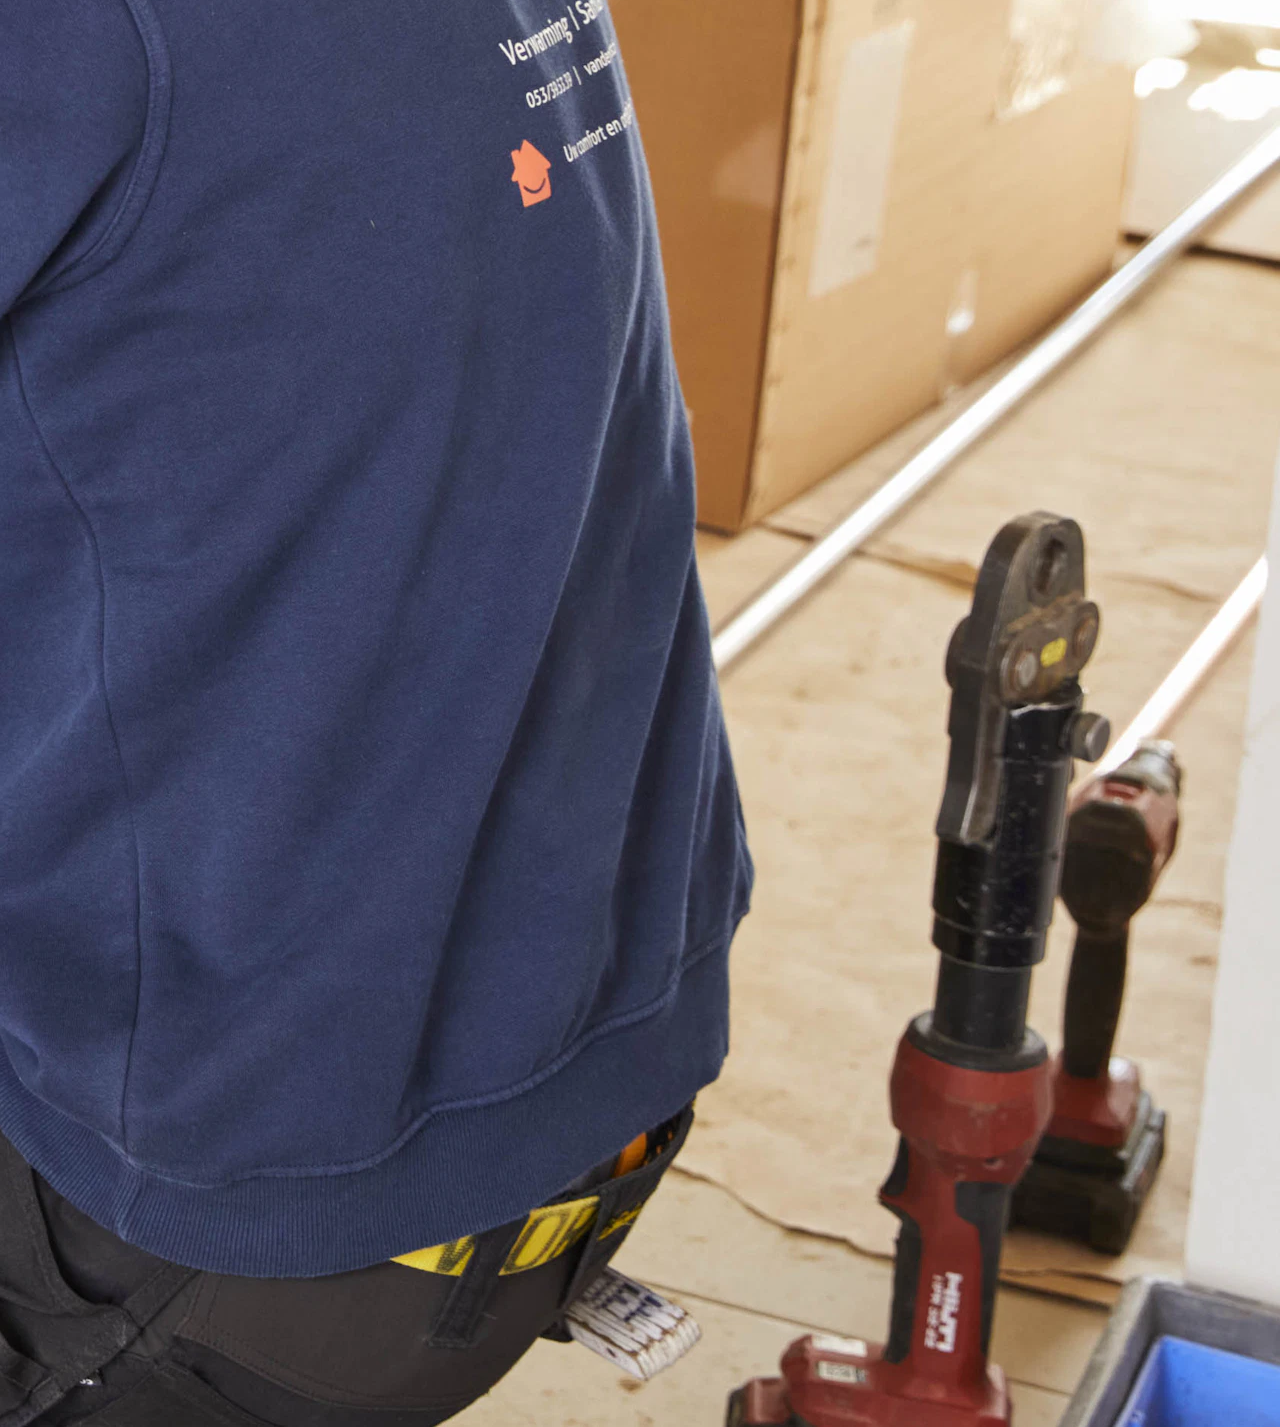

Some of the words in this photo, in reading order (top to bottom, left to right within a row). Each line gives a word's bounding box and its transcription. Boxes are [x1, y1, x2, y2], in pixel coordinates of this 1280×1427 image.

[498, 17, 574, 66] Verwarming
[576, 126, 608, 155] comfort
[605, 118, 623, 137] en
[936, 1271, 964, 1353] HILTI
